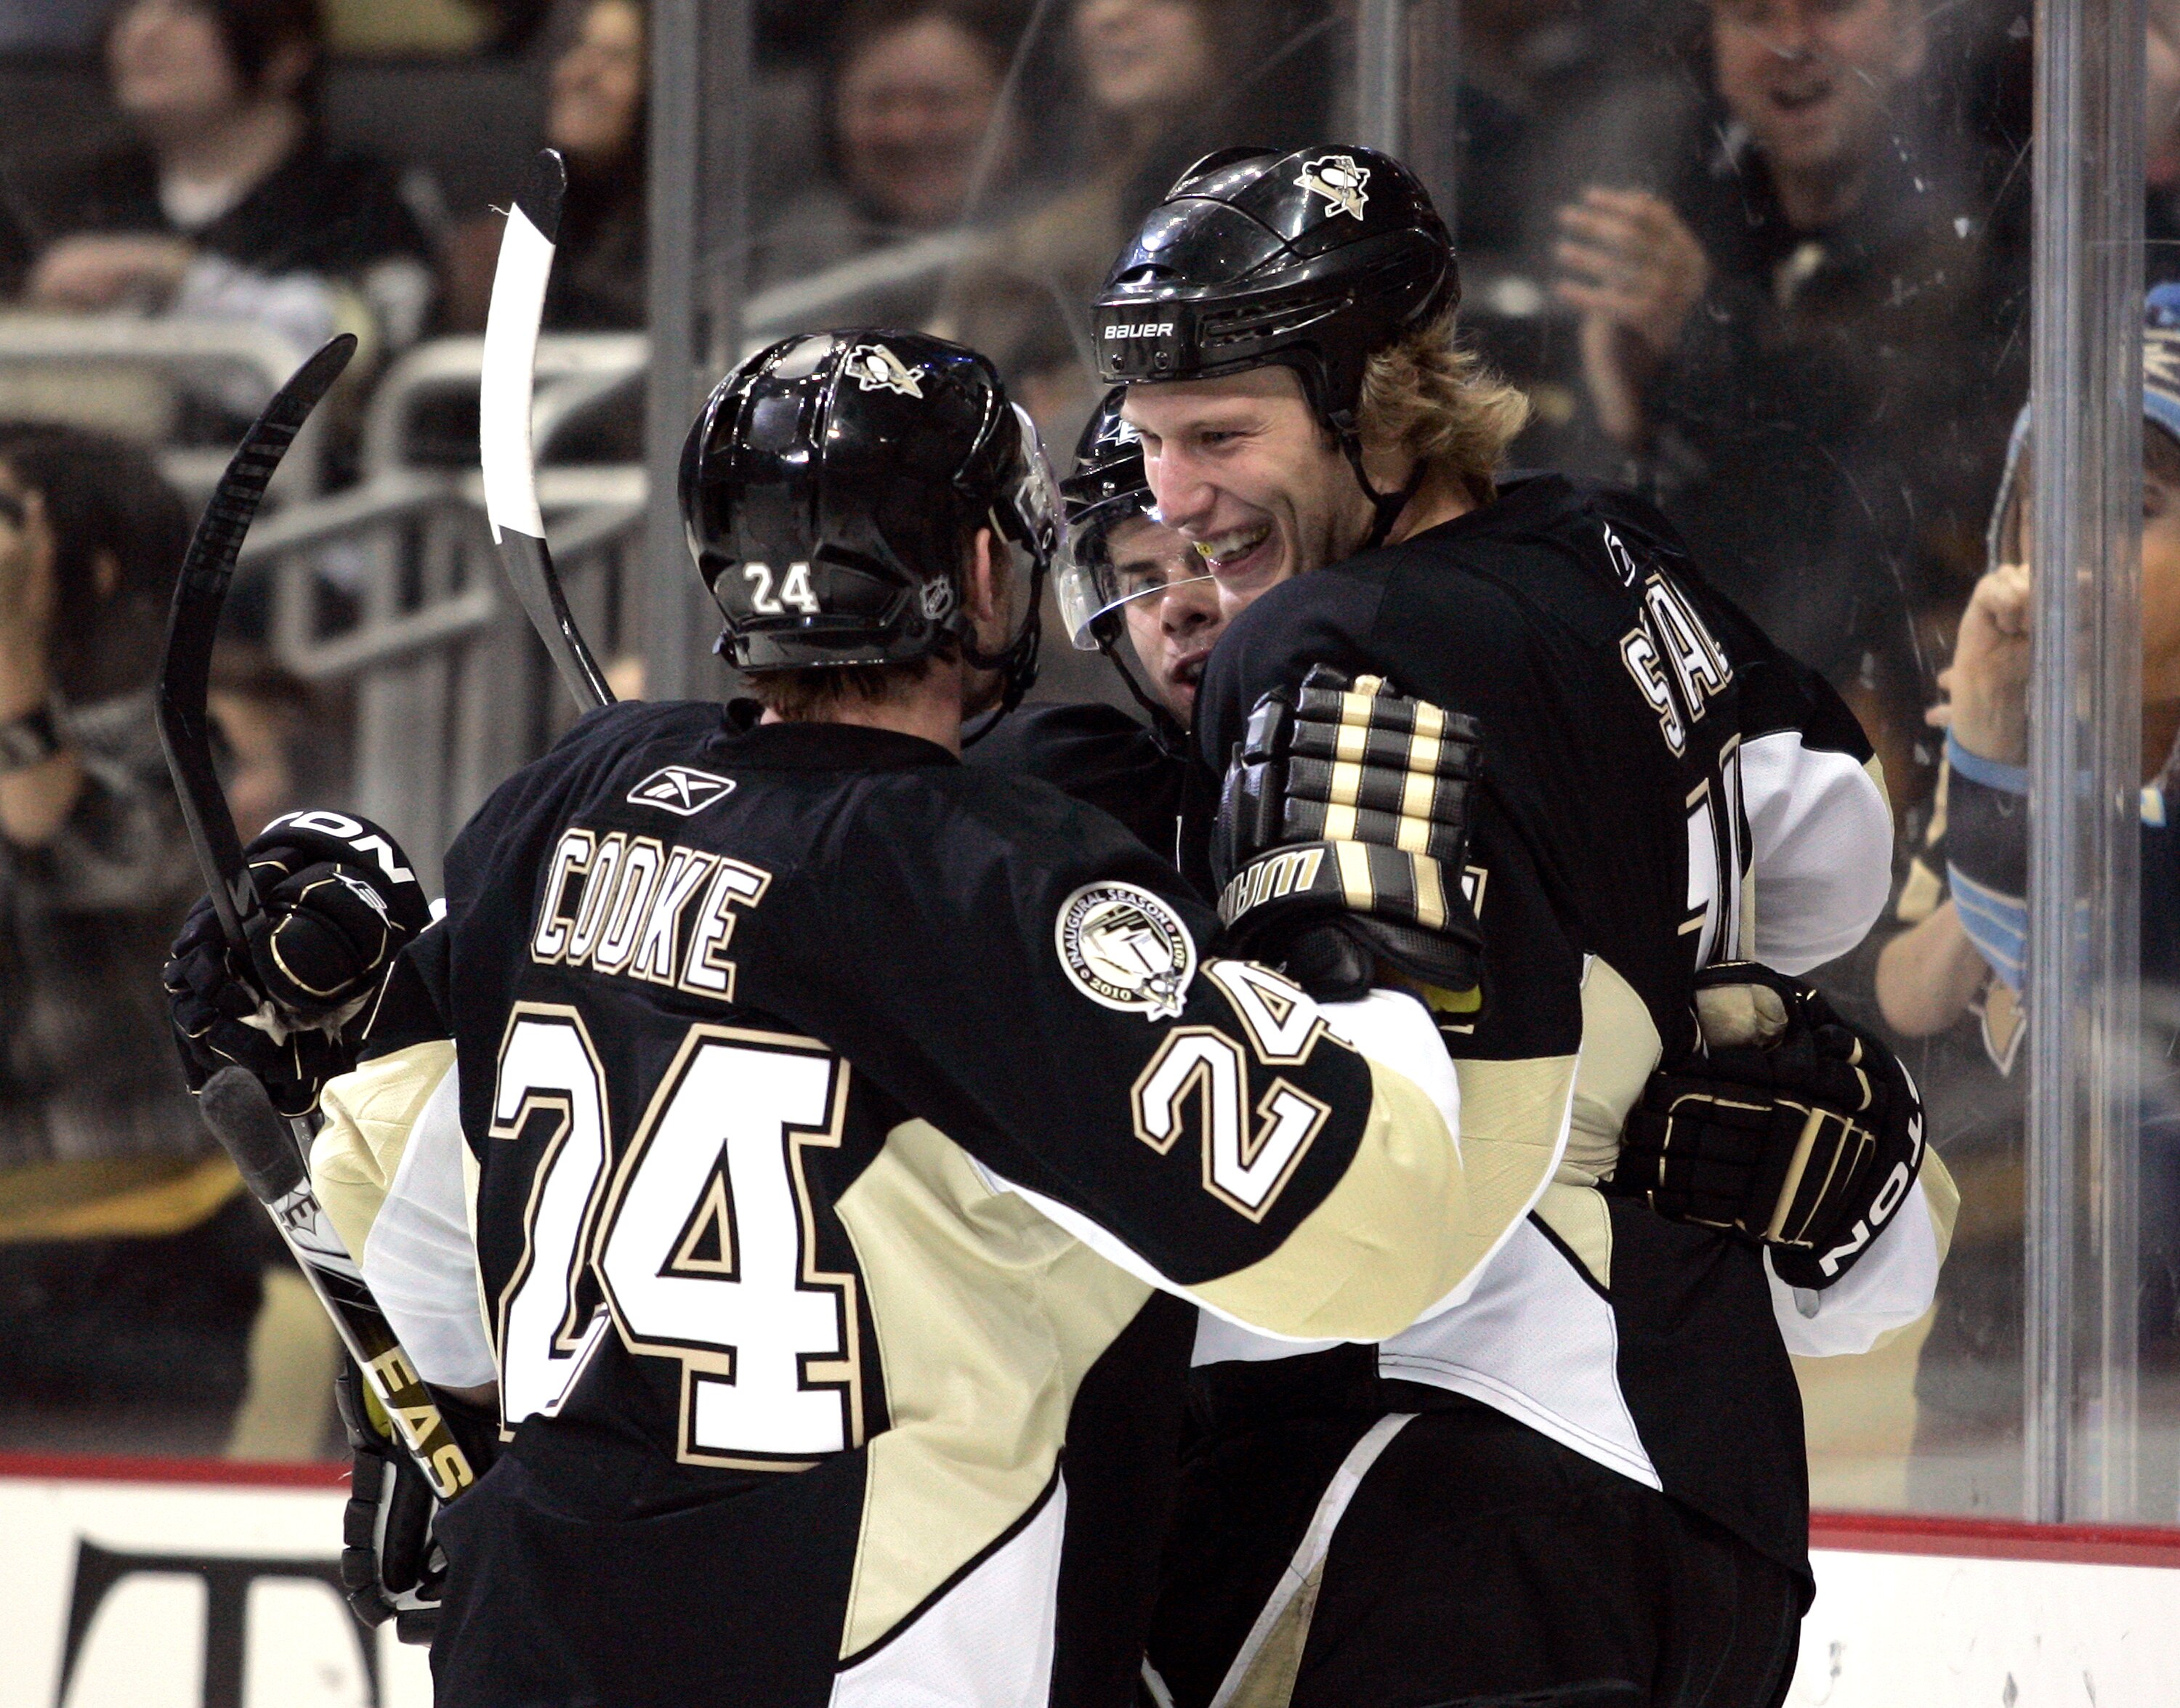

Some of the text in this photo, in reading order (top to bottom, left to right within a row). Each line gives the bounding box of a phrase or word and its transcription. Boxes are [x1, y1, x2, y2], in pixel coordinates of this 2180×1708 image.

[1105, 323, 1174, 340] BAUER
[743, 561, 821, 615] 24
[530, 827, 772, 1003] COOKE
[1065, 889, 1171, 969] INAUGURAL SEASON
[1089, 978, 1132, 1002] 2010
[1130, 955, 1357, 1224] 24
[488, 1000, 865, 1473] 24
[363, 1345, 474, 1499] EAS
